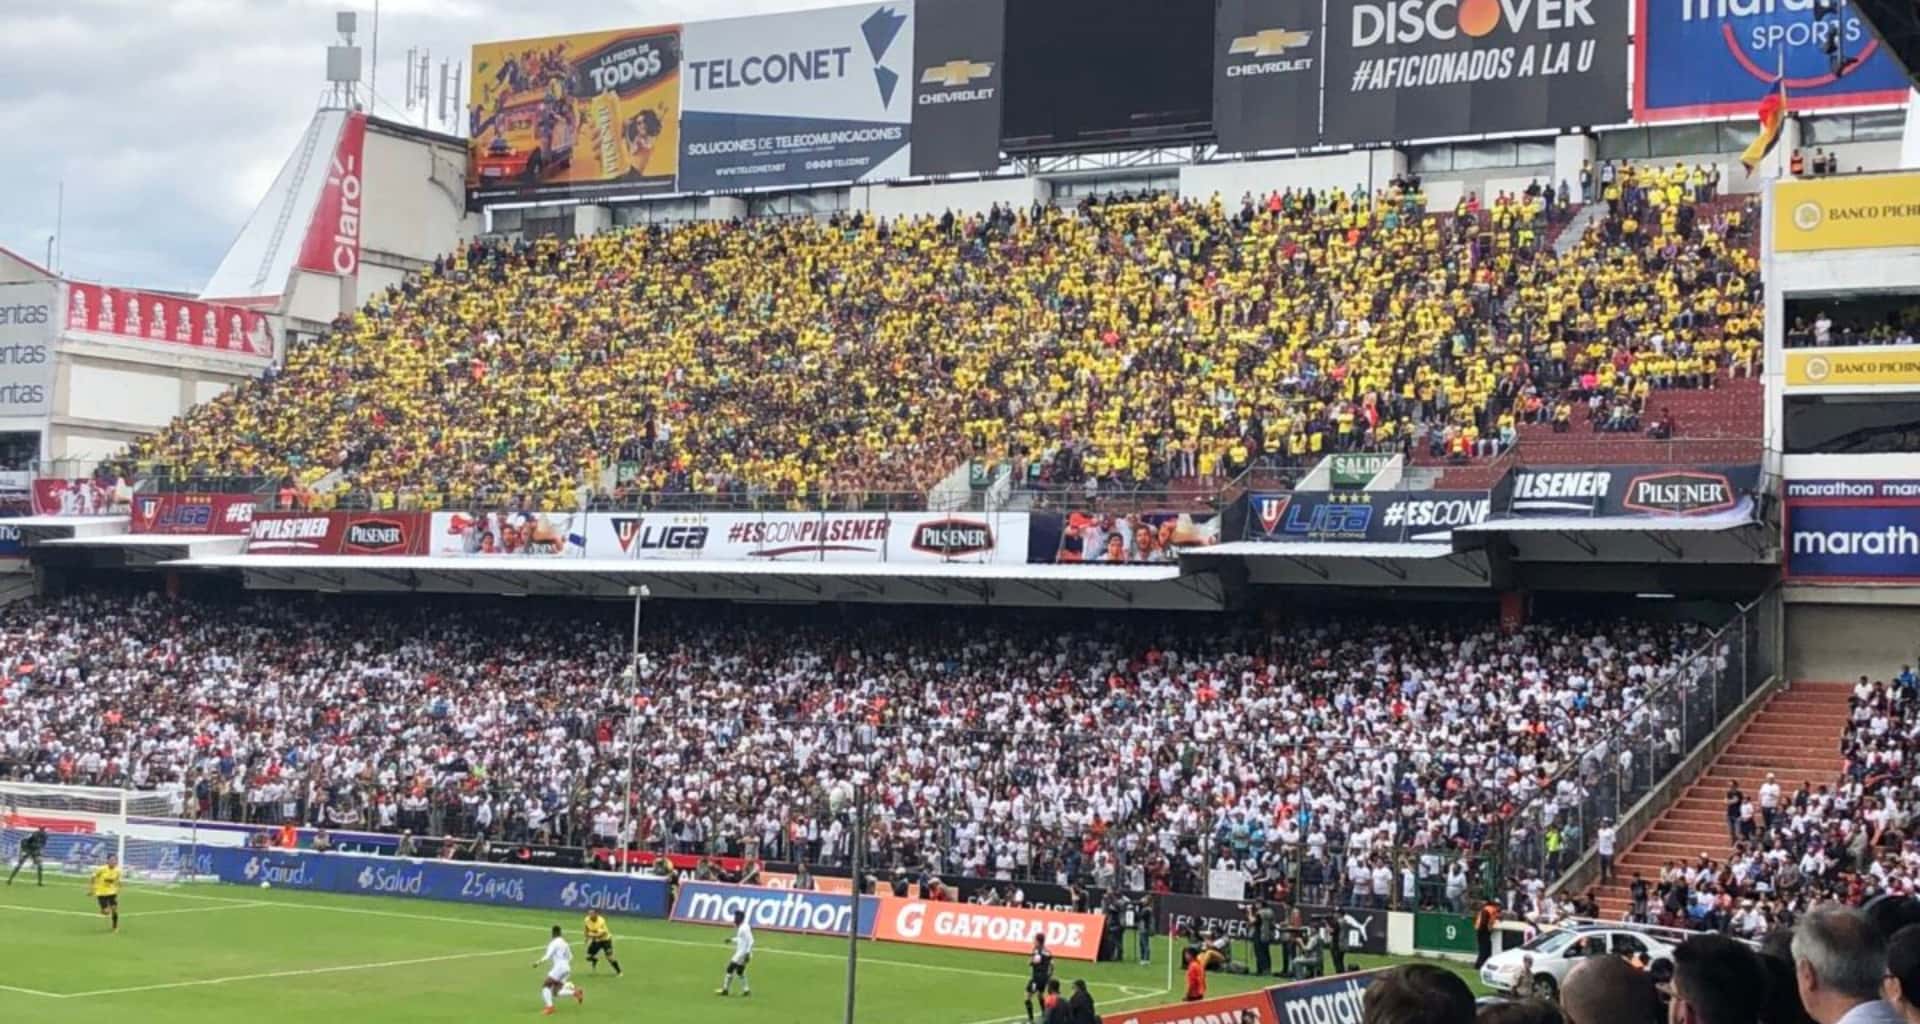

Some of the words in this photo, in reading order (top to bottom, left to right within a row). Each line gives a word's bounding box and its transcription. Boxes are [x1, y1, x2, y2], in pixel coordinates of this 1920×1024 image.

[1352, 0, 1597, 47] DISCOVER
[590, 49, 661, 90] TODOS
[689, 47, 851, 91] TELCONET
[1226, 58, 1313, 77] CHEVROLET
[1350, 47, 1516, 92] #AFICIONADOS
[1518, 45, 1535, 77] A
[1541, 41, 1571, 75] LA
[1577, 39, 1597, 72] U
[919, 88, 995, 105] CHEVROLET
[688, 137, 757, 156] SOLUCIONES
[758, 136, 774, 151] DE
[776, 127, 902, 149] TELECOMUNICACIONES
[1829, 205, 1879, 221] BANCO
[0, 382, 45, 404] ntas
[1638, 482, 1724, 503] PILSENER
[1788, 481, 1874, 496] marathon
[350, 525, 401, 543] PILSENER
[921, 527, 985, 546] PILSENER
[374, 867, 423, 894] Salud
[578, 883, 631, 911] Salud
[896, 903, 926, 937] G
[934, 911, 1085, 948] GATORADE
[1445, 925, 1457, 940] 9
[1285, 979, 1367, 1024] marath
